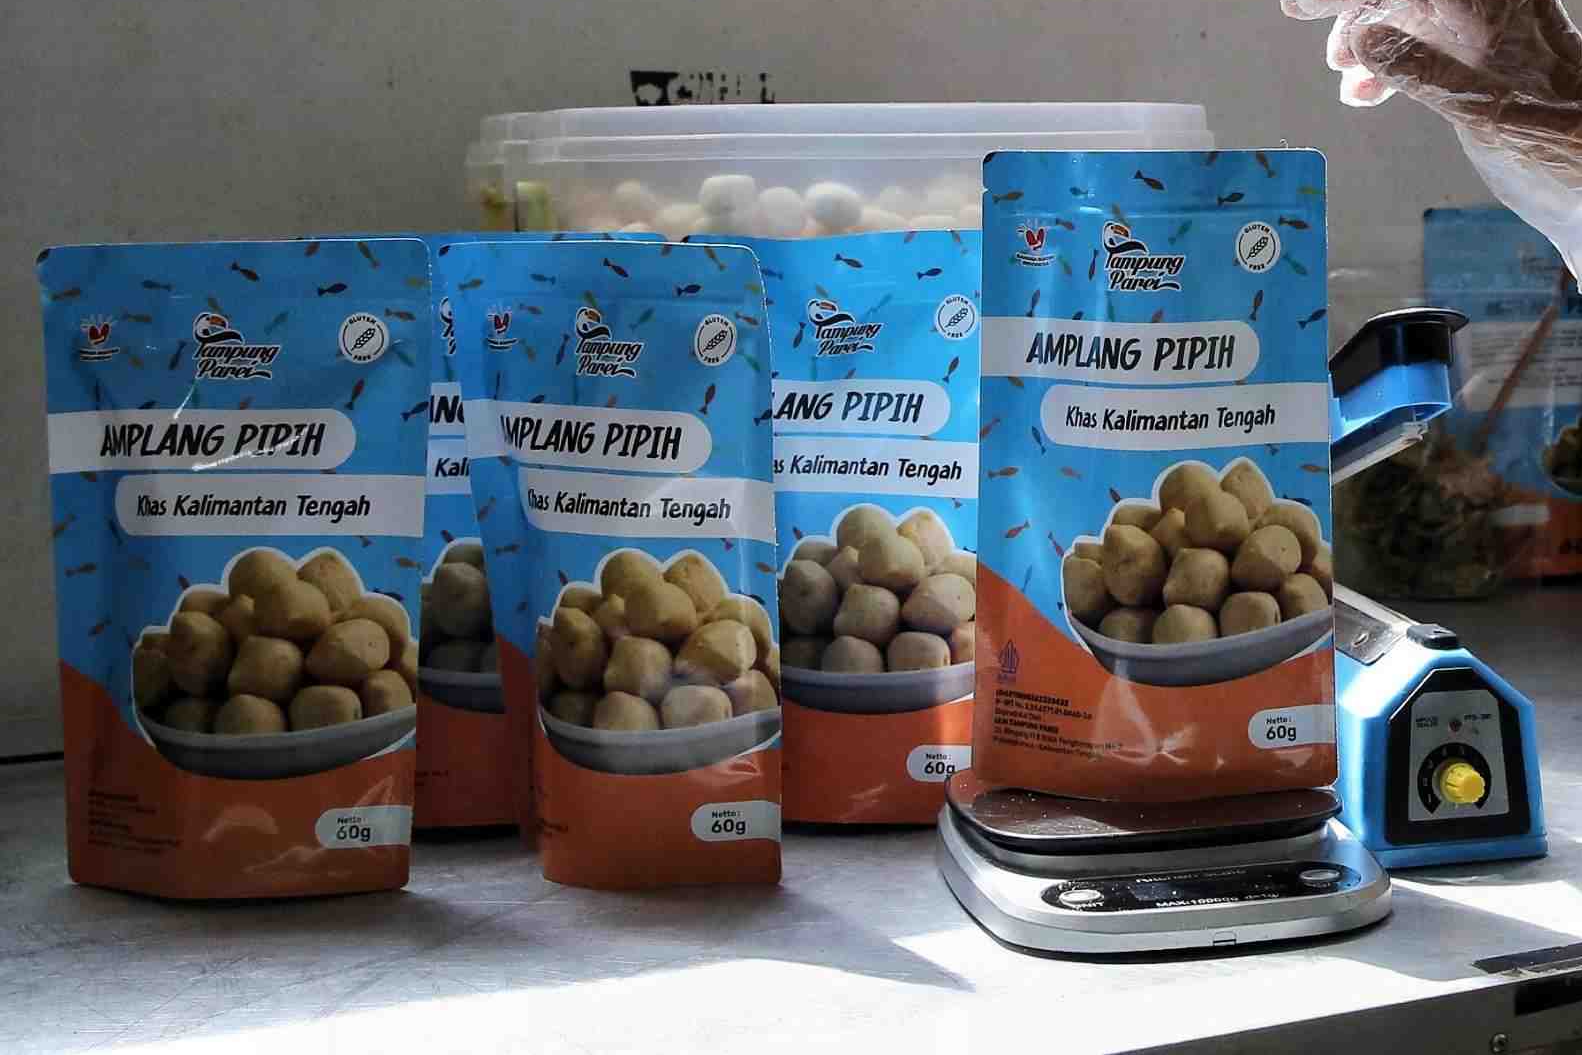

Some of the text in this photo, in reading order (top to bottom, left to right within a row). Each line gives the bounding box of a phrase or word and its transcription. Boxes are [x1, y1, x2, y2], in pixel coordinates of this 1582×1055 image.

[1104, 240, 1186, 275] Tampung
[1108, 269, 1182, 291] Parei
[192, 332, 281, 364] Tampung
[576, 326, 644, 362] Tampung
[1025, 331, 1235, 371] AMPLANG PIPIH
[841, 391, 924, 424] PIPIH
[1065, 404, 1276, 433] Khas Kalimantan Tengah
[100, 422, 326, 457] AMPLANG PIPIH
[602, 422, 682, 461] PIPIH
[790, 453, 890, 477] Kalimantan
[898, 458, 962, 486] Tengah
[136, 493, 371, 523] Khas Kalimantan Tengah
[553, 490, 651, 519] Kalimantan
[660, 497, 731, 526] Tengah
[1266, 725, 1297, 742] 60g
[924, 761, 956, 775] 60g
[336, 825, 371, 842] 60g
[711, 819, 747, 835] 60g
